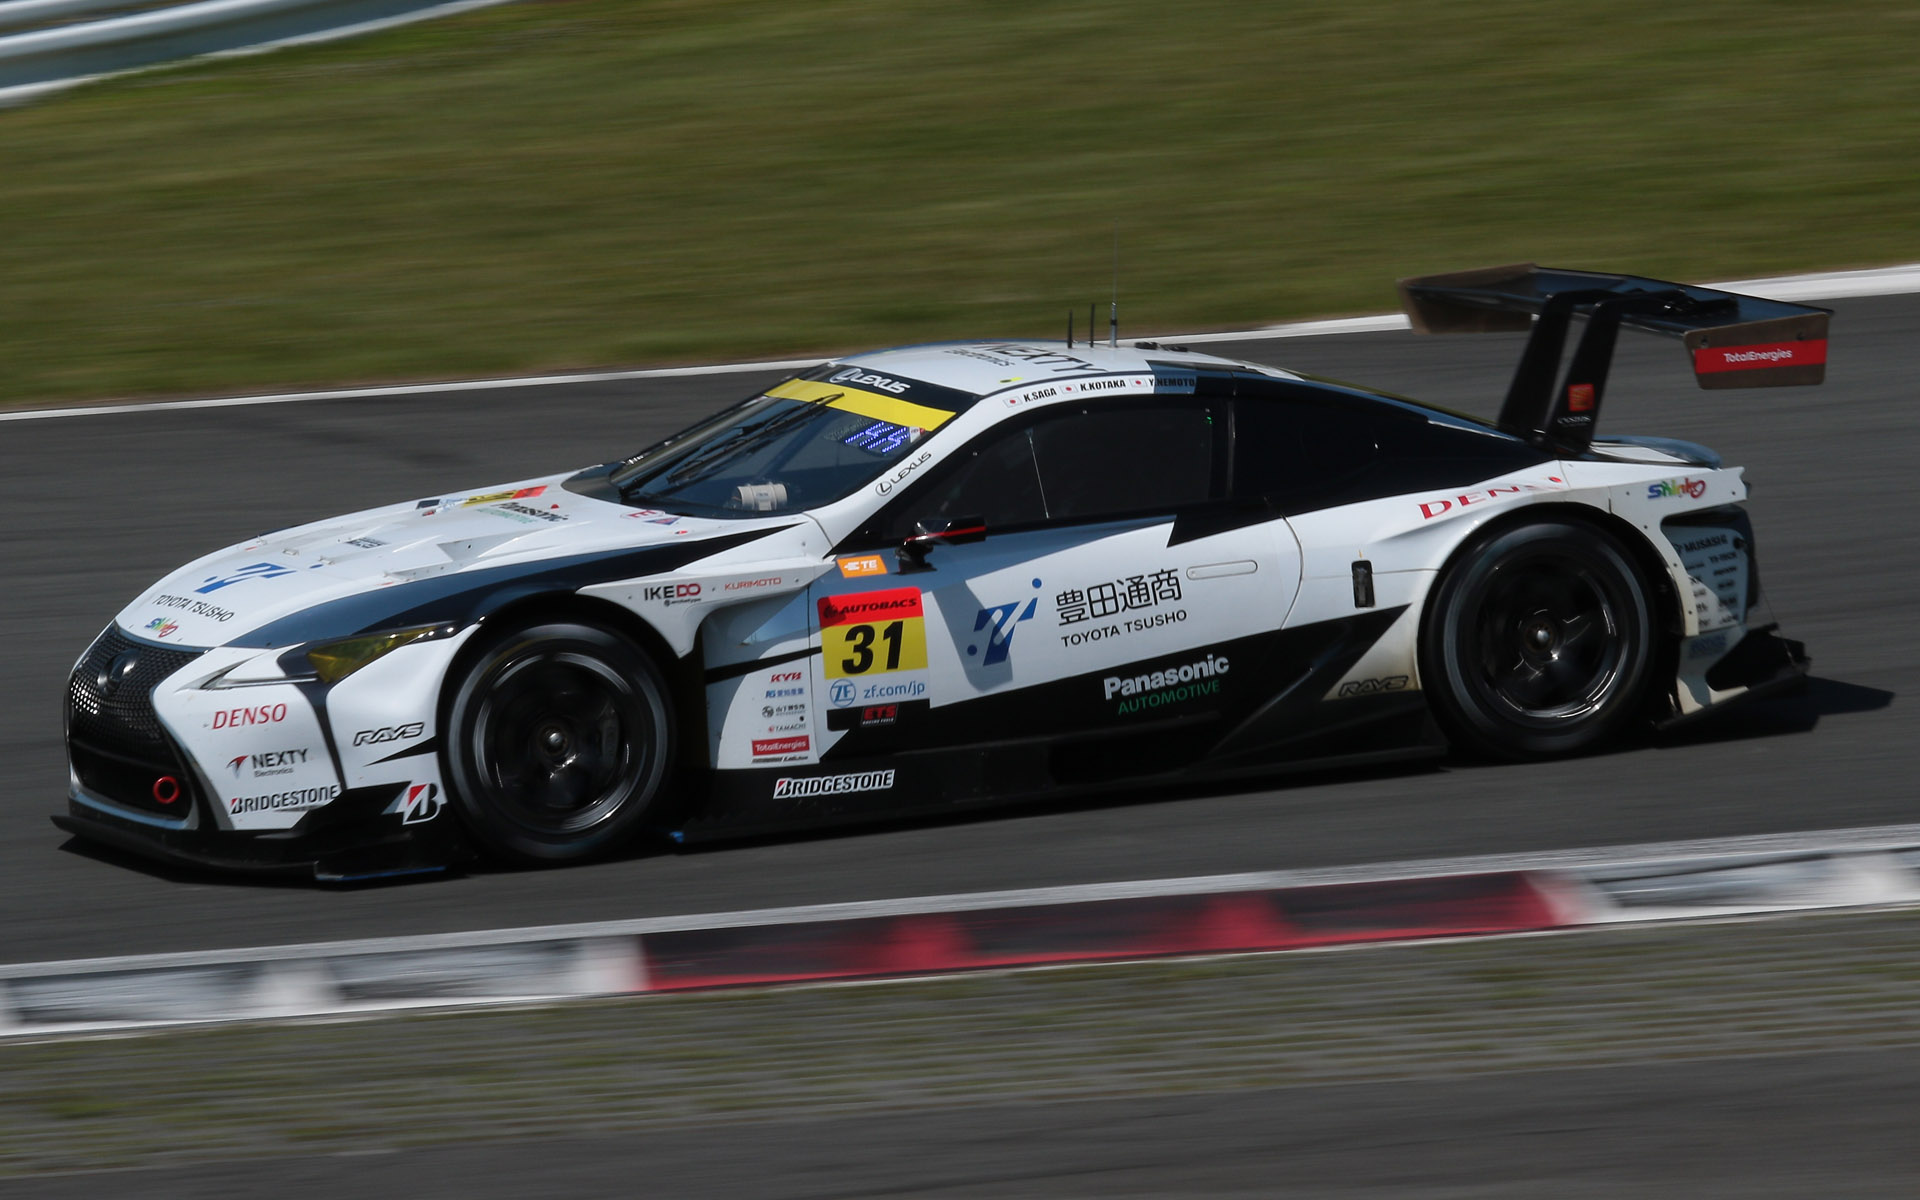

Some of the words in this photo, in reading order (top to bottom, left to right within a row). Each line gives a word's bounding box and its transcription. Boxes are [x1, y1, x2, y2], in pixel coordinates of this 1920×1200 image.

[1723, 348, 1793, 362] TotalEnergies
[850, 375, 911, 394] LEXUS
[1080, 379, 1127, 392] K.KOTAKA
[1149, 378, 1196, 389] Y.NEMOTO
[1023, 388, 1057, 403] K.SAGA
[890, 451, 932, 484] LEXUS
[1684, 534, 1729, 553] MUSASHI
[860, 559, 877, 569] TE
[644, 583, 702, 601] IKEDO
[724, 576, 782, 591] KURIMOTO
[839, 597, 917, 615] AUTOBACS
[1055, 567, 1183, 627] 豊田通商
[152, 594, 193, 610] TOYOTA
[187, 601, 235, 622] TSUSHO
[1061, 625, 1121, 648] TOYOTA
[1124, 609, 1188, 634] TSUSHO
[842, 620, 904, 675] 31
[770, 671, 802, 683] KYB
[1103, 654, 1230, 700] Panasonic
[831, 681, 855, 705] ZF
[863, 680, 925, 700] zf.com/jp
[1118, 679, 1220, 716] AUTOMOTIVE
[211, 703, 288, 730] DENSO
[863, 704, 897, 720] ETS
[353, 722, 425, 747] RAYS
[755, 740, 807, 753] TotalEnergies
[252, 748, 310, 770] NEXTY
[254, 766, 294, 779] Electronics
[774, 769, 895, 799] BRIDGESTONE
[230, 784, 342, 816] BRIDGESTONE
